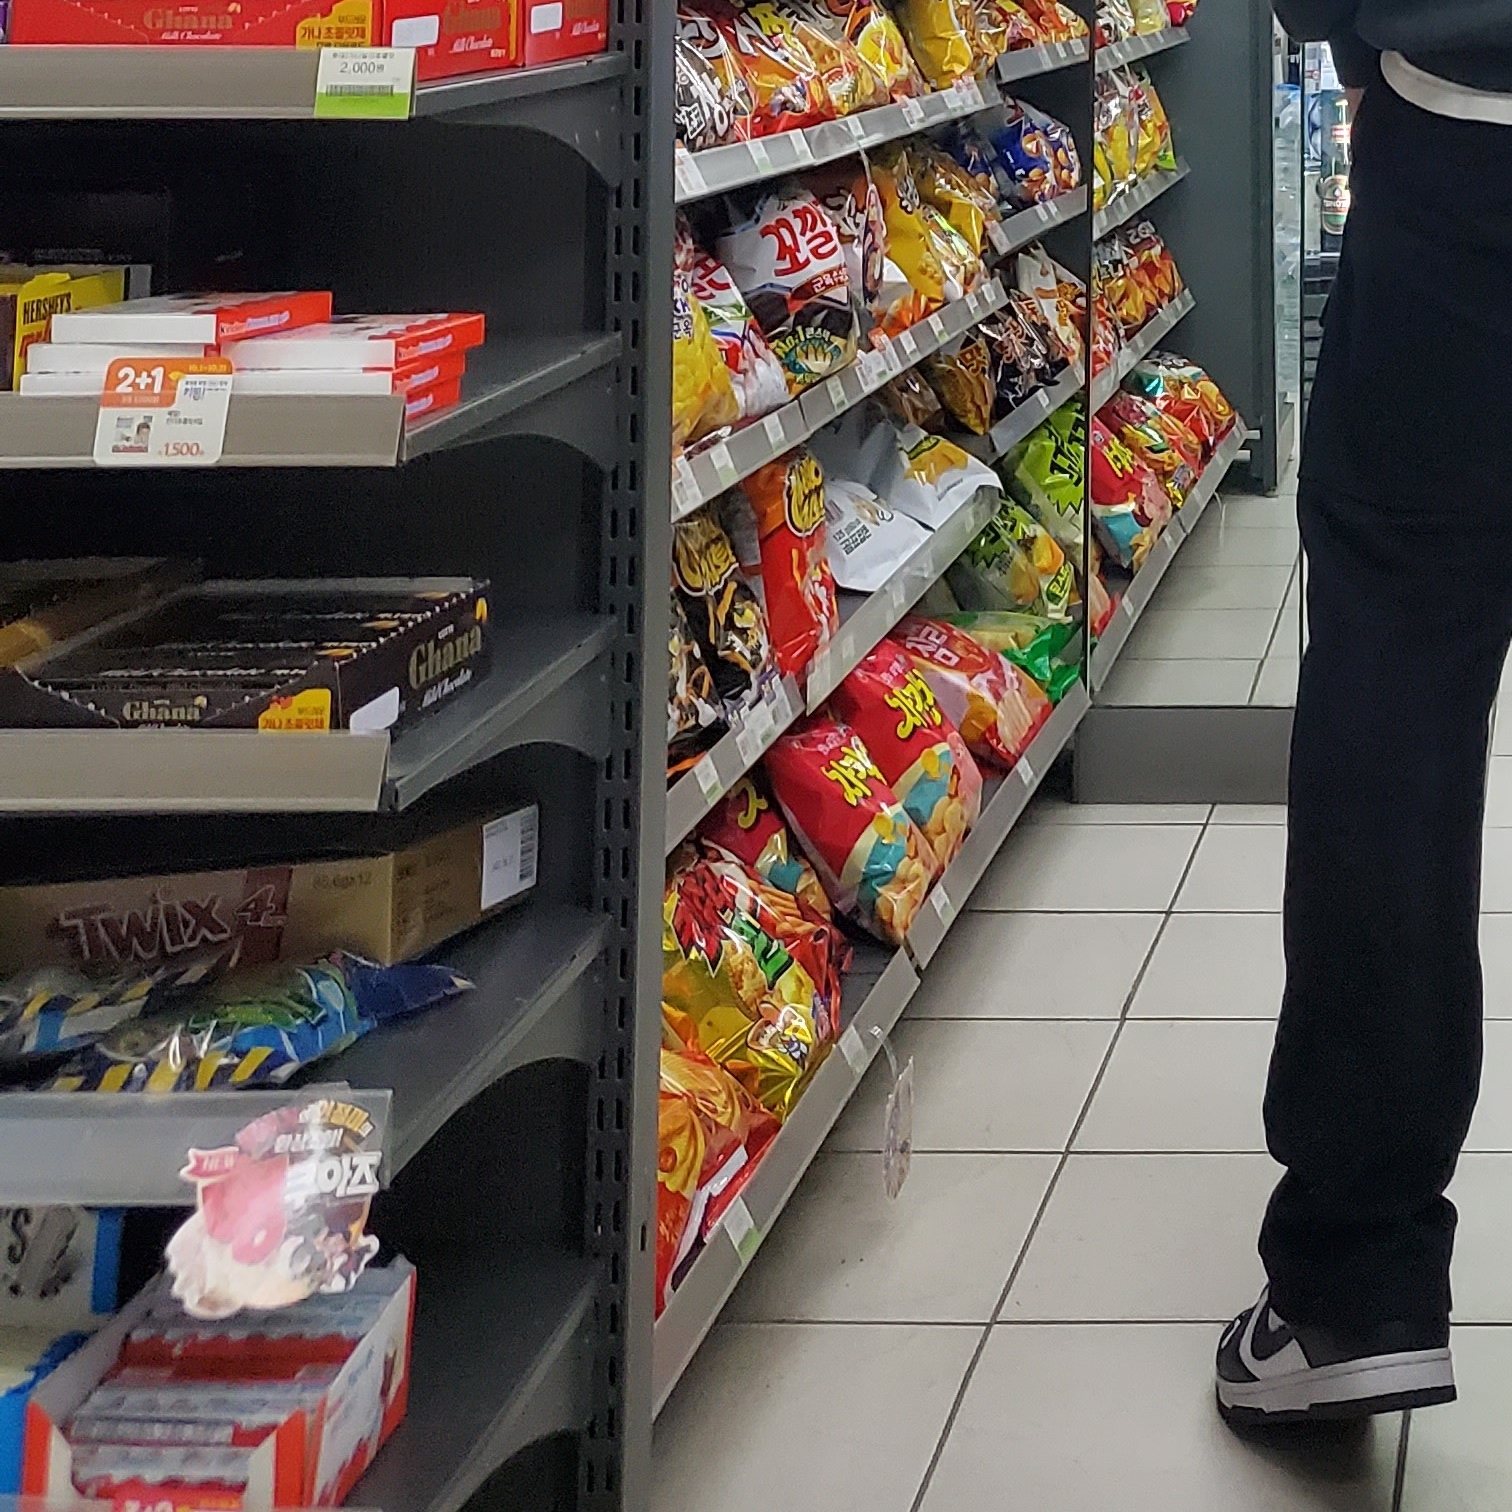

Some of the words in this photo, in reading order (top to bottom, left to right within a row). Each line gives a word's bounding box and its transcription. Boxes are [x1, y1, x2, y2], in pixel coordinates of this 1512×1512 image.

[143, 8, 233, 29] Ghana
[340, 61, 385, 75] 2,000원
[22, 291, 73, 326] HERSHEY'S
[116, 367, 164, 394] 2+1
[408, 626, 483, 690] Ghana
[122, 699, 203, 721] Ghana
